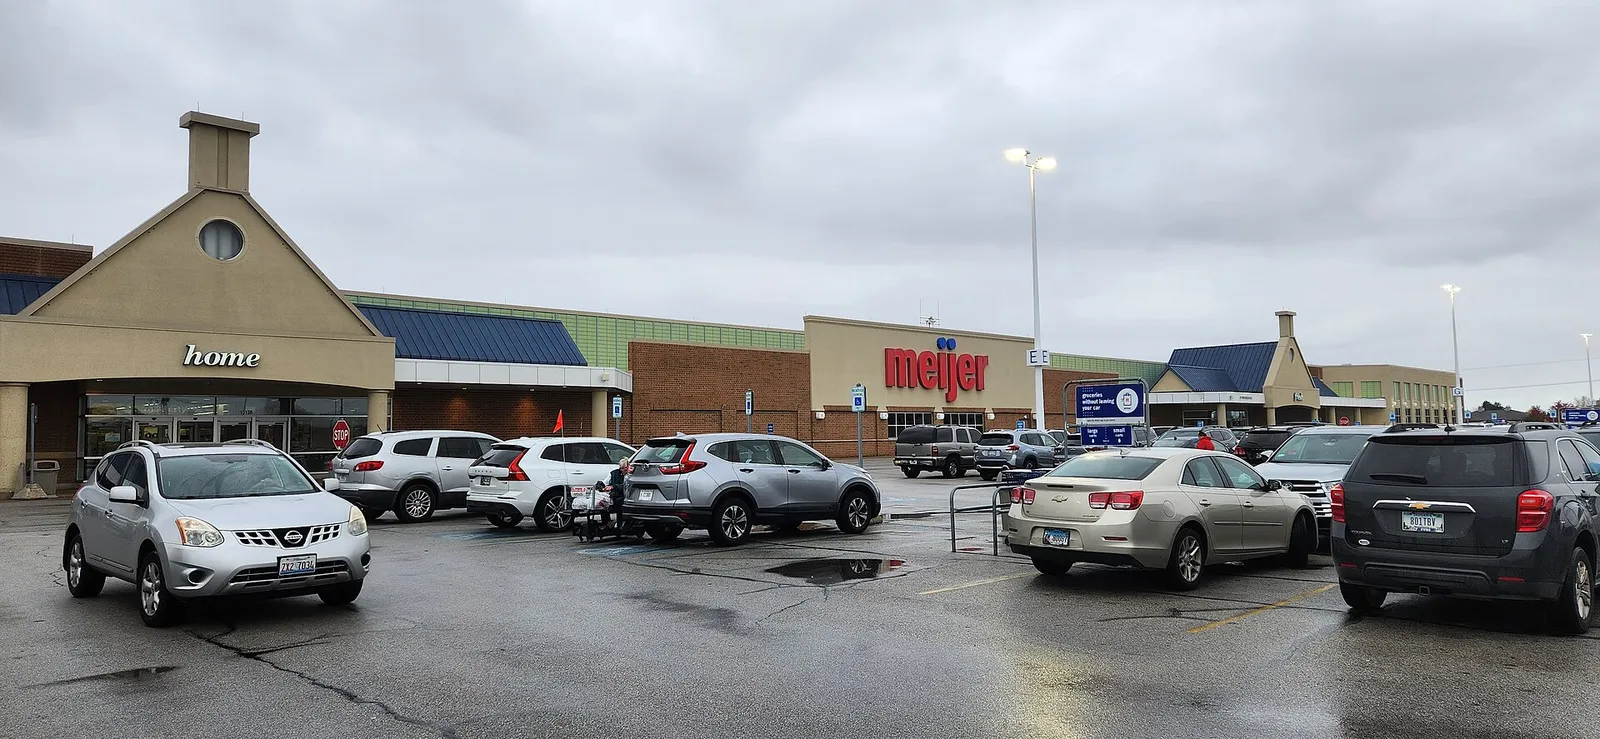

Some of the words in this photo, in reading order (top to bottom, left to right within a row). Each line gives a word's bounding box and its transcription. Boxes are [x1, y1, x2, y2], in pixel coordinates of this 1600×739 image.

[182, 343, 260, 368] home
[1030, 350, 1038, 363] E
[1042, 350, 1049, 363] E
[885, 337, 988, 402] meijer
[1082, 392, 1103, 400] groceries
[1454, 387, 1461, 395] G
[334, 429, 349, 441] STOP
[1410, 516, 1436, 527] 801TBV
